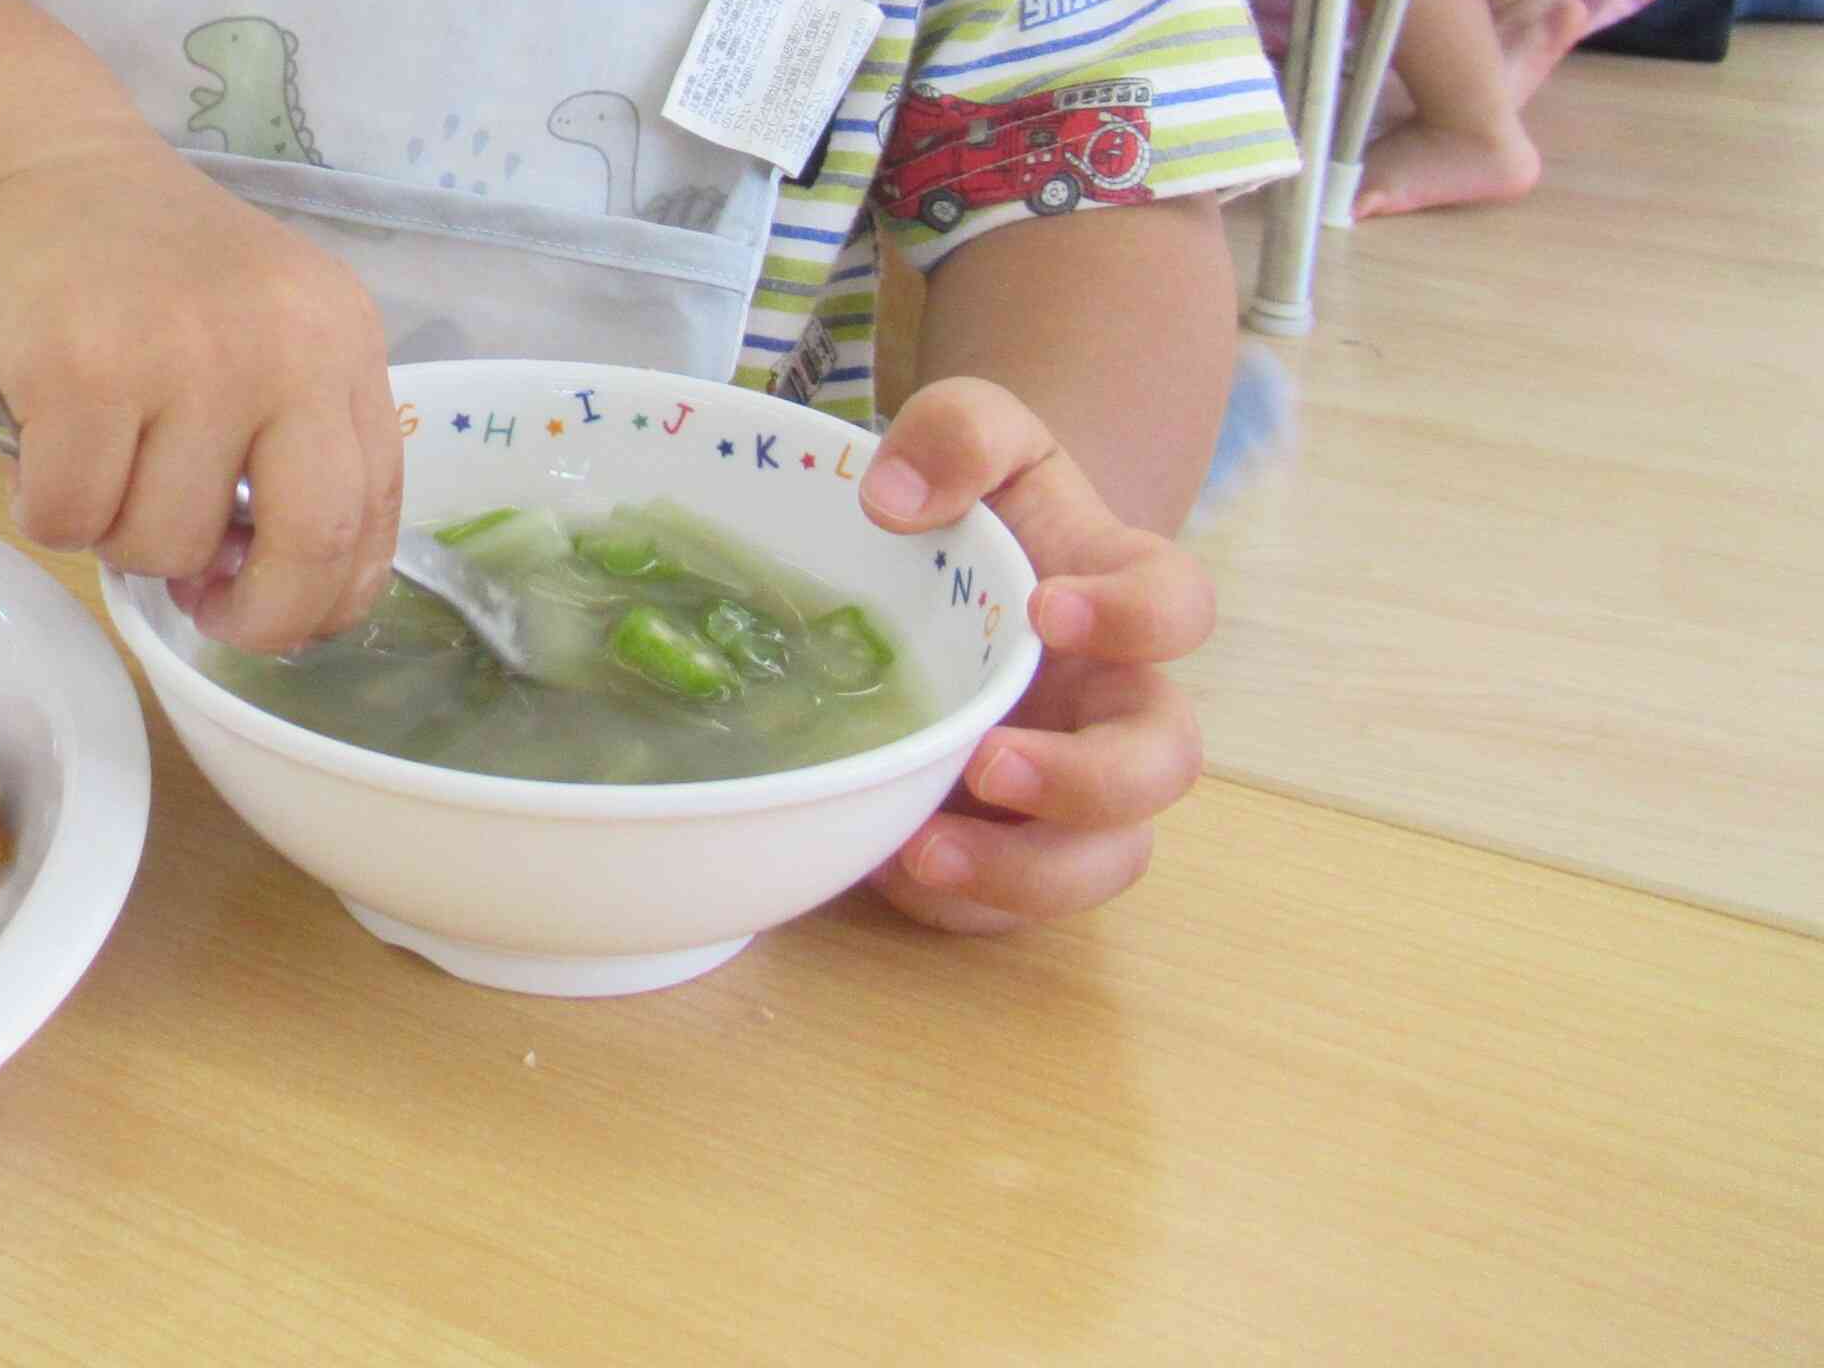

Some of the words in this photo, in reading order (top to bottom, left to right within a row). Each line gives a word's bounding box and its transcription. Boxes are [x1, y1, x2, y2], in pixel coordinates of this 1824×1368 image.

[483, 411, 517, 447] H
[575, 389, 601, 424] I
[663, 401, 695, 435] J
[756, 432, 780, 469] K
[834, 439, 854, 480] L
[951, 566, 973, 608] N
